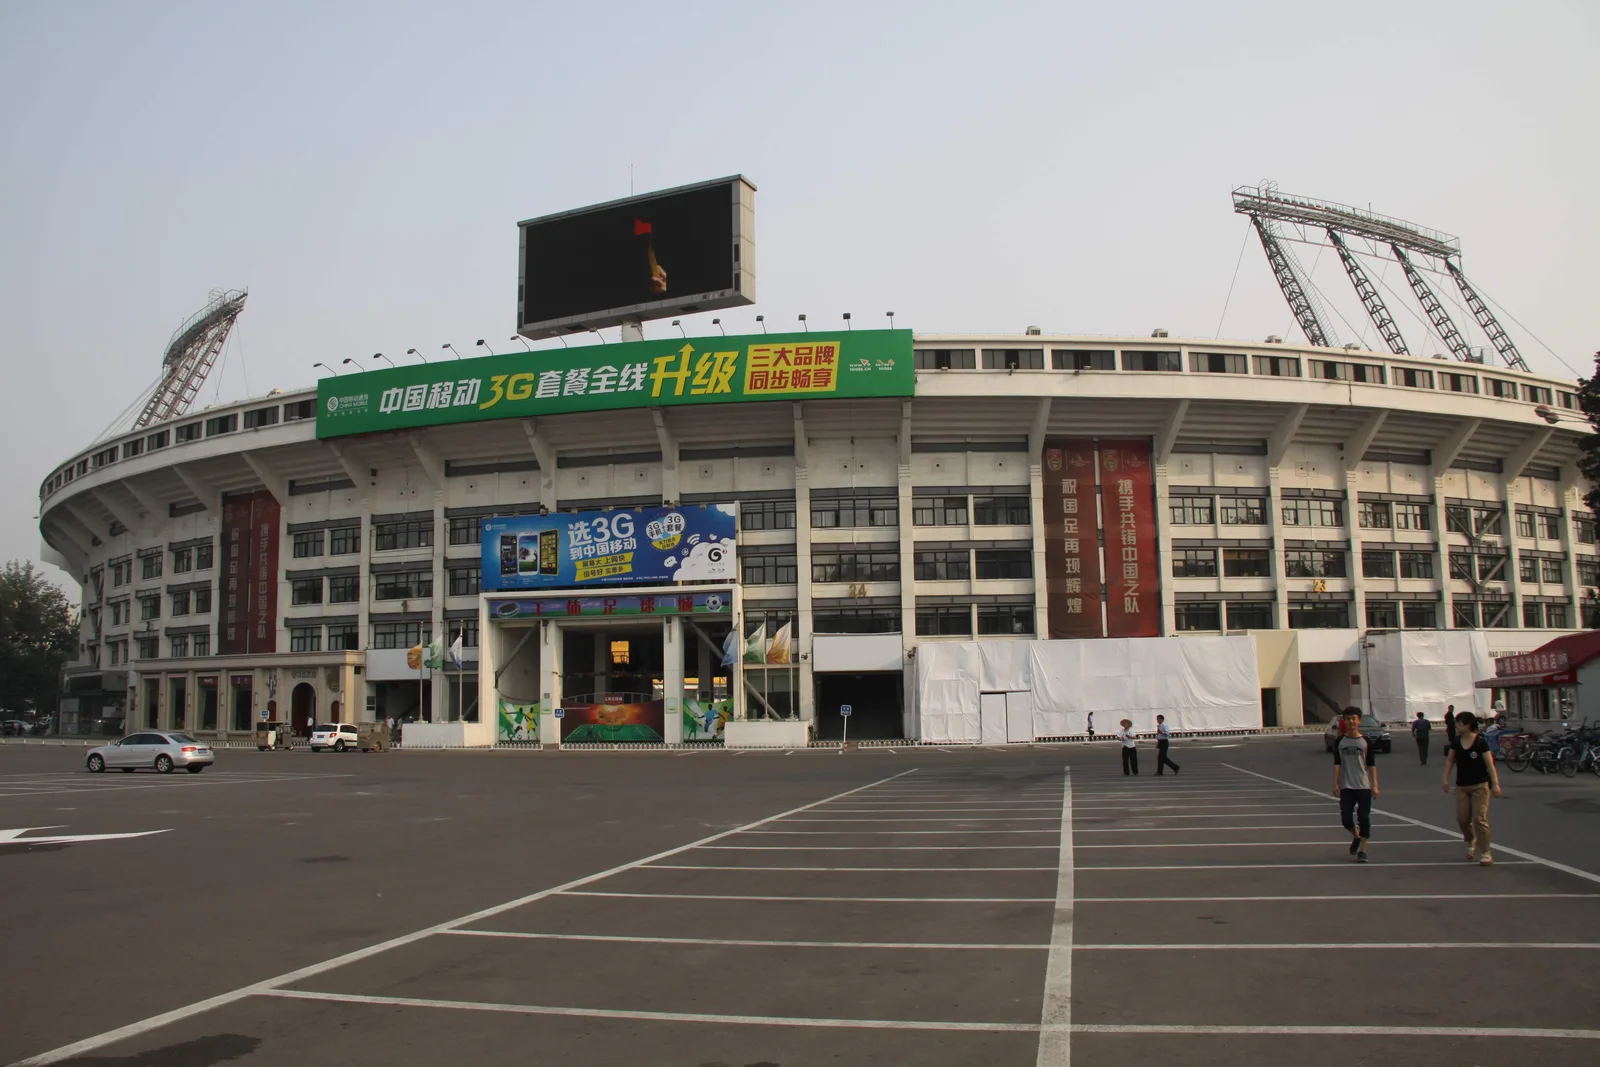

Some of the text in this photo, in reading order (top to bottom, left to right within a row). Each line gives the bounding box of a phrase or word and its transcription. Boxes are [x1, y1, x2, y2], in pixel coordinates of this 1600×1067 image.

[752, 345, 834, 367] 三大品牌
[379, 343, 740, 415] 中国移动3G套餐全线升级
[749, 368, 832, 390] 同步畅享
[647, 522, 660, 532] 3G
[666, 524, 682, 532] 套餐
[667, 515, 681, 524] 3G
[567, 513, 635, 548] 选3G
[649, 529, 663, 538] 手机
[569, 538, 637, 561] 到中国移动
[1062, 478, 1082, 613] 祝国足再现辉煌
[1117, 479, 1140, 613] 携手共铸中国之队
[582, 555, 626, 568] 屏幕大 上网快
[583, 566, 624, 578] 信号好 实惠多
[848, 583, 867, 598] 24
[1312, 579, 1327, 593] 23
[534, 595, 693, 617] 工体足球城
